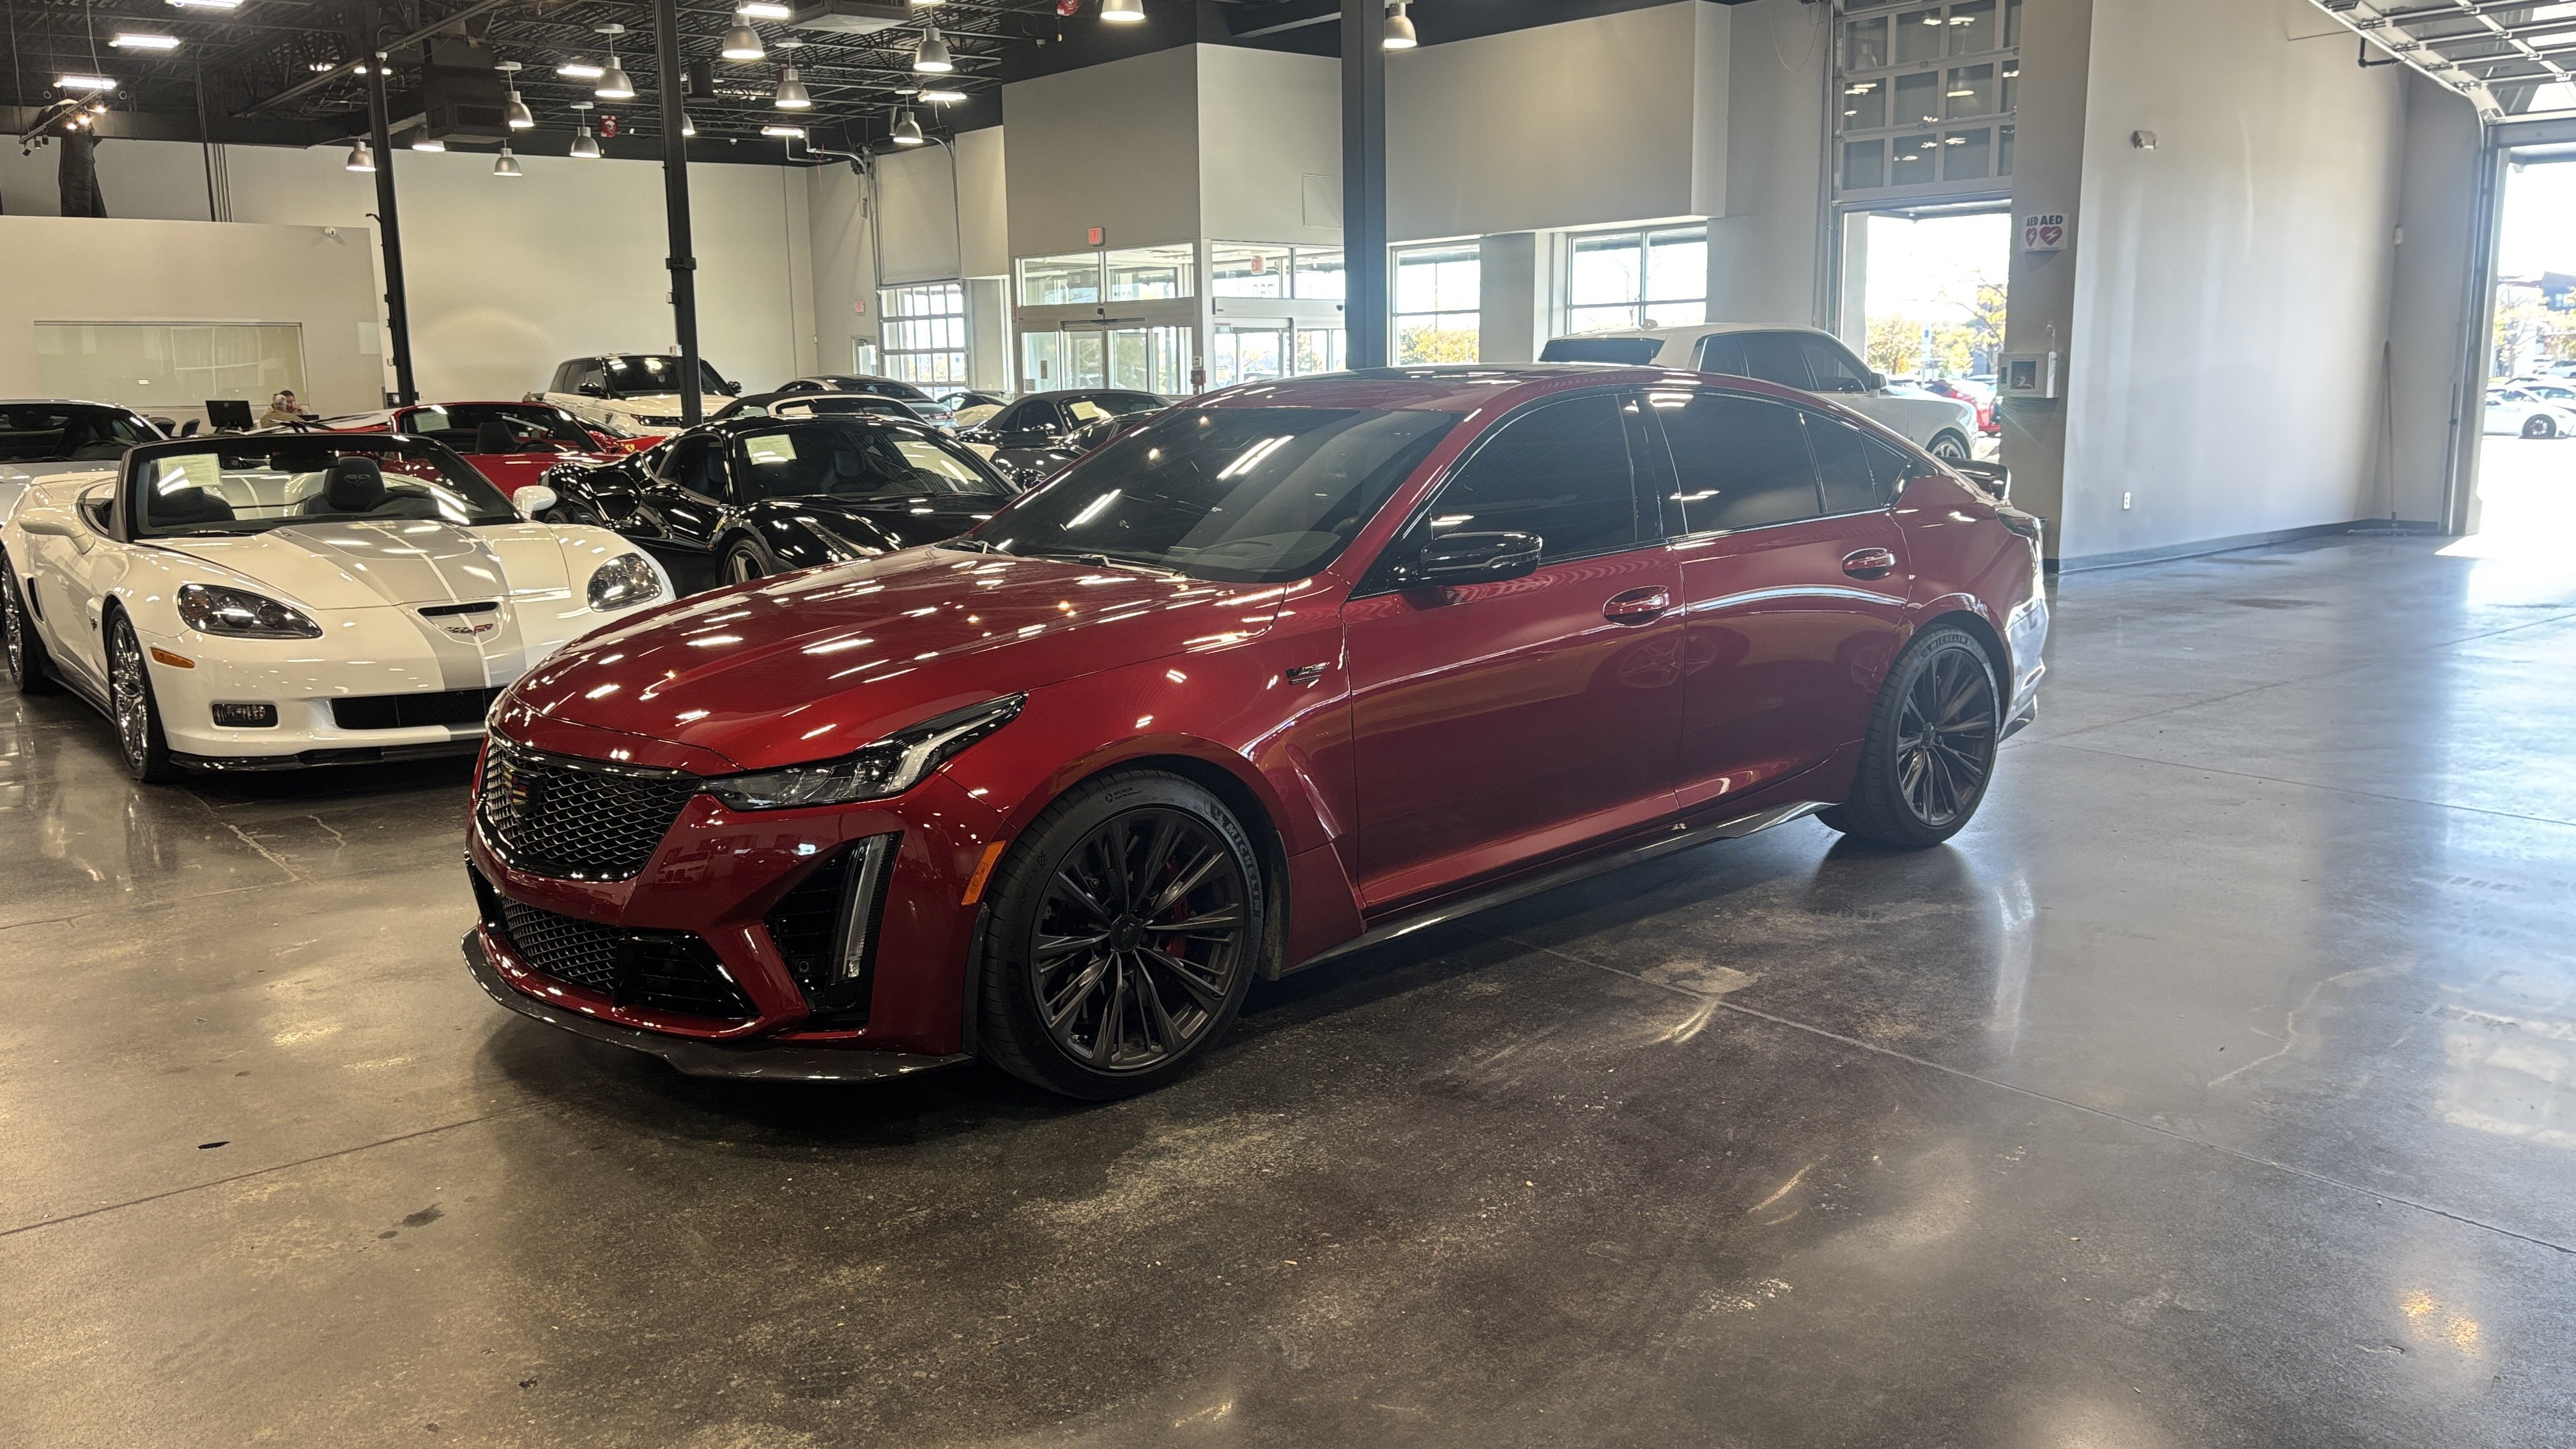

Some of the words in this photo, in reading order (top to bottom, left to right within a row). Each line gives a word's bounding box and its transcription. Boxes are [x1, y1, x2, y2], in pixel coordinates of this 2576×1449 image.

[2026, 217, 2038, 226] AED
[2039, 215, 2063, 226] AED
[1931, 634, 1966, 650] MICHELIN
[1225, 822, 1261, 912] MICHELIN
